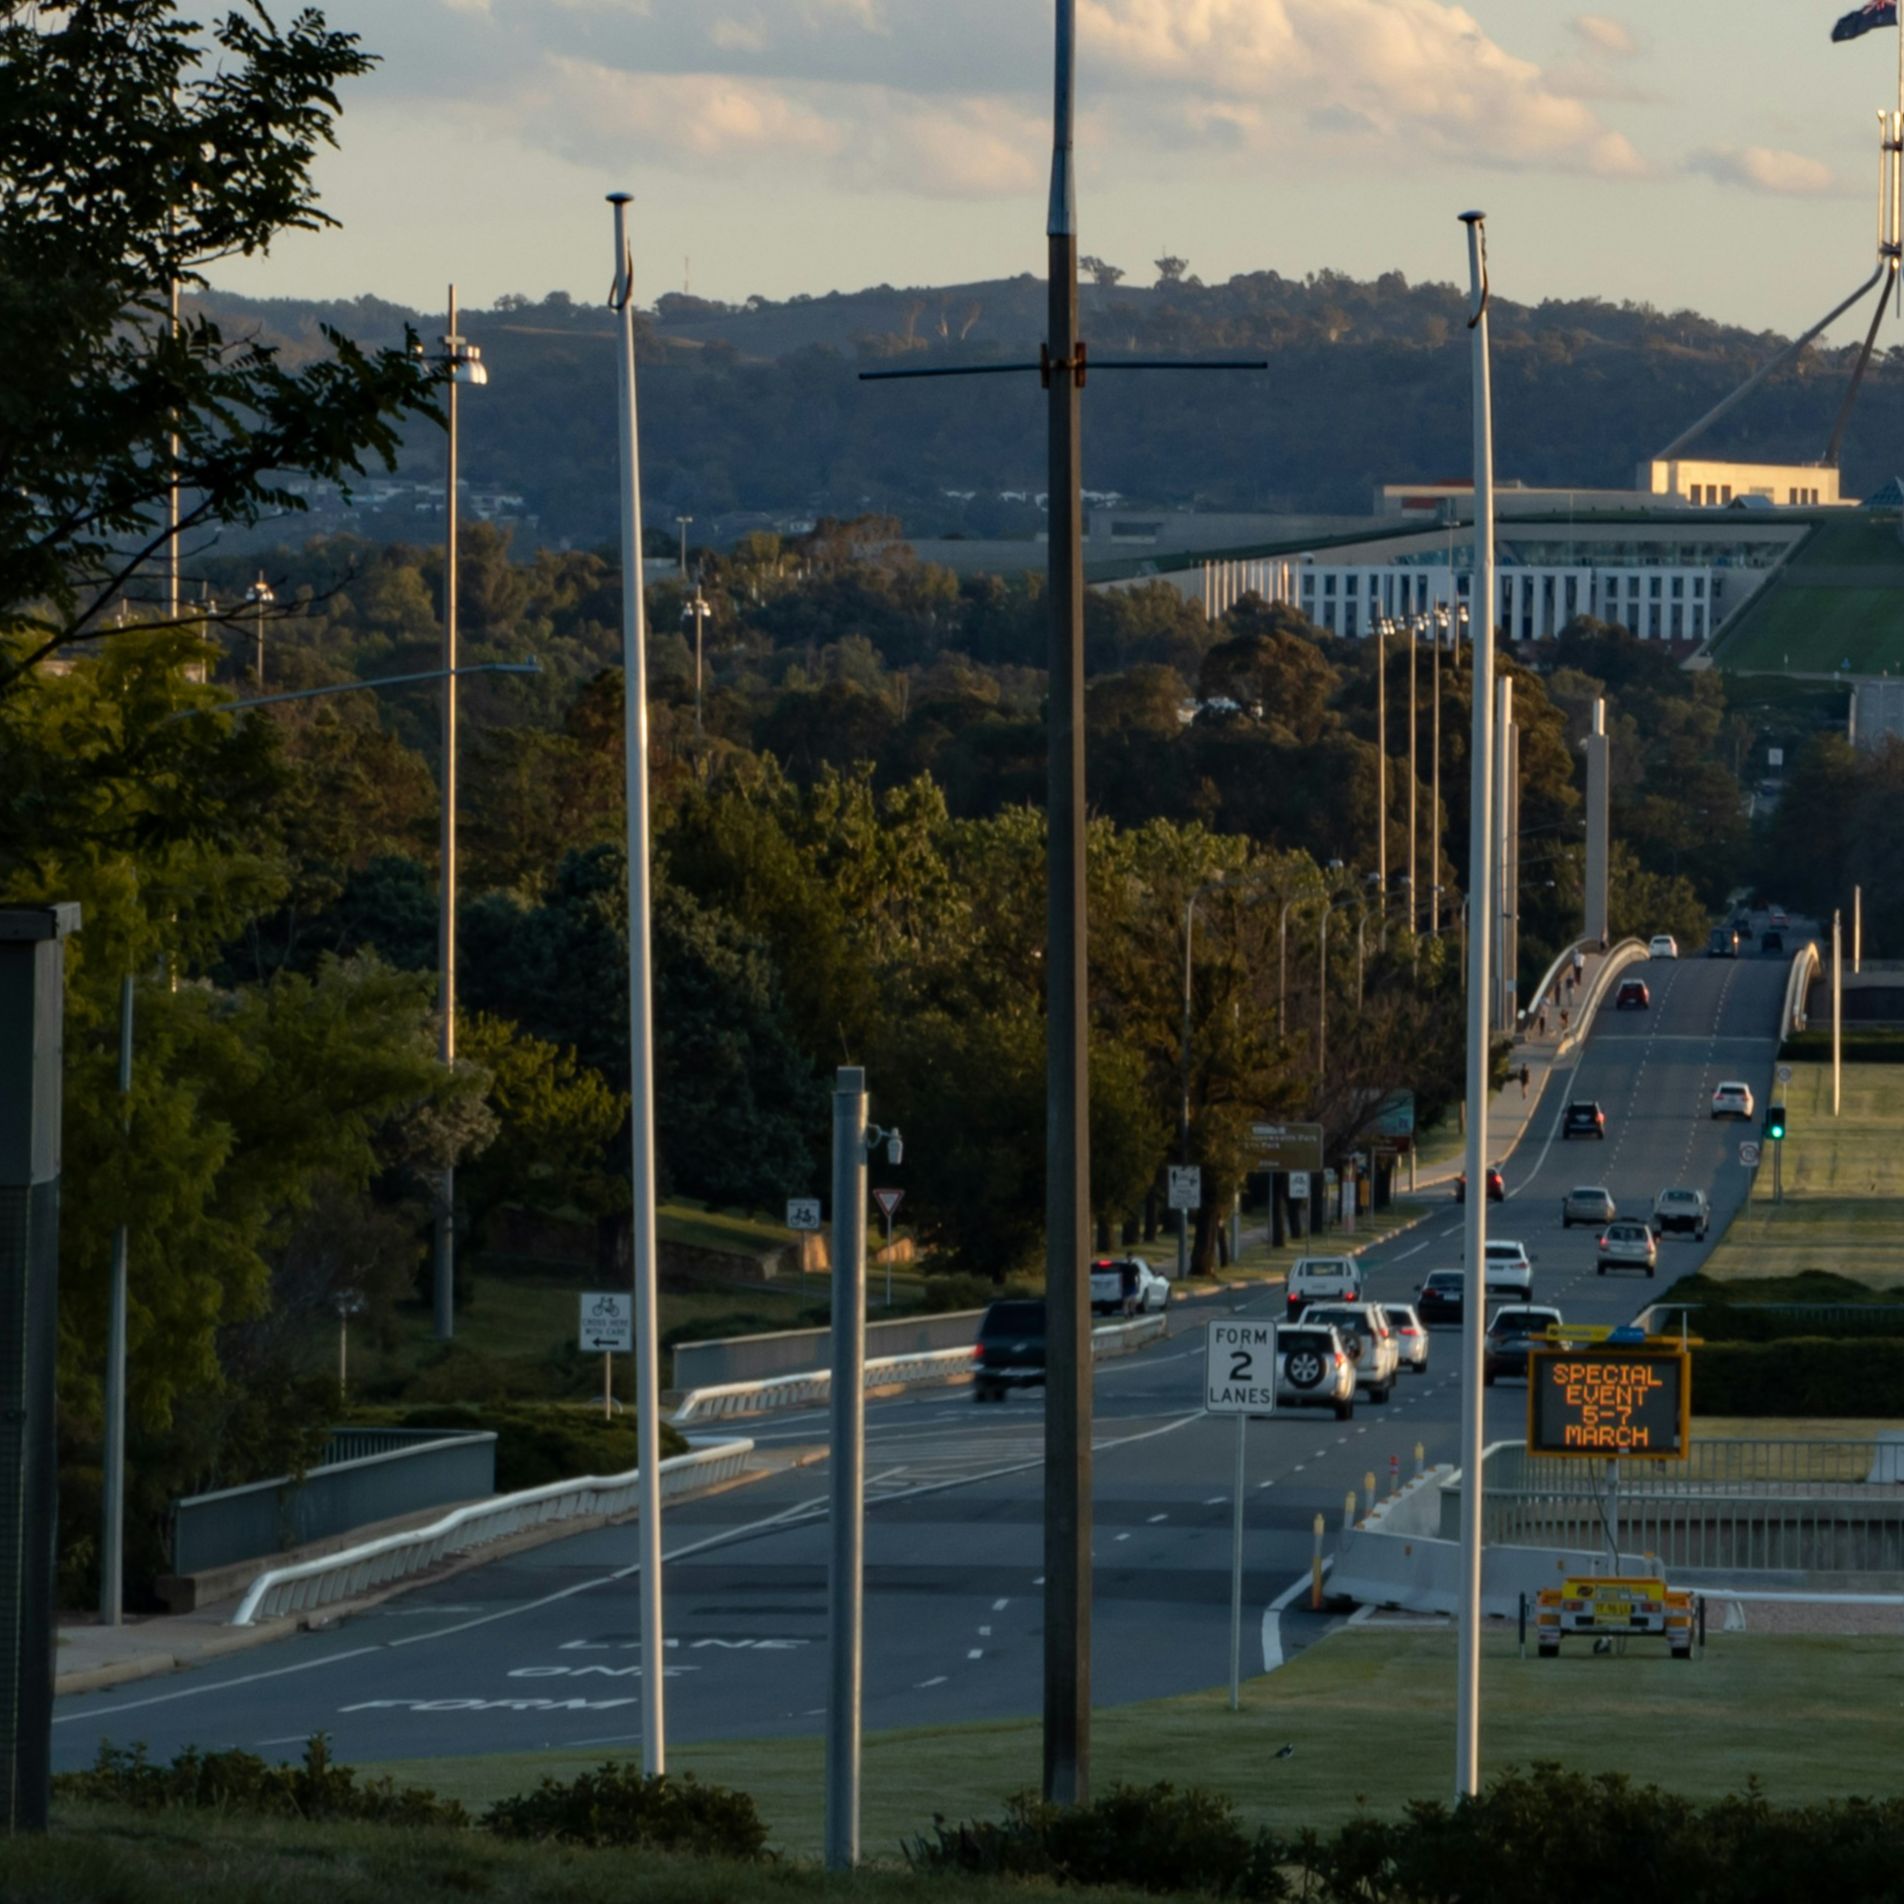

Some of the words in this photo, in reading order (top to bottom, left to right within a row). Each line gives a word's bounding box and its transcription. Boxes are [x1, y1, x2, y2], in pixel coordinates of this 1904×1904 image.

[607, 1328, 625, 1336] CARE
[1216, 1328, 1267, 1344] FORM
[1229, 1351, 1252, 1380] 2
[1553, 1364, 1663, 1386] SPECIAL
[1210, 1387, 1270, 1404] LANES
[1567, 1385, 1648, 1406] EVENT
[1583, 1405, 1632, 1425] 5-7
[1565, 1425, 1648, 1447] MARCH
[558, 1639, 811, 1649] LANE
[507, 1665, 702, 1677] ONE
[337, 1698, 640, 1712] FORM
